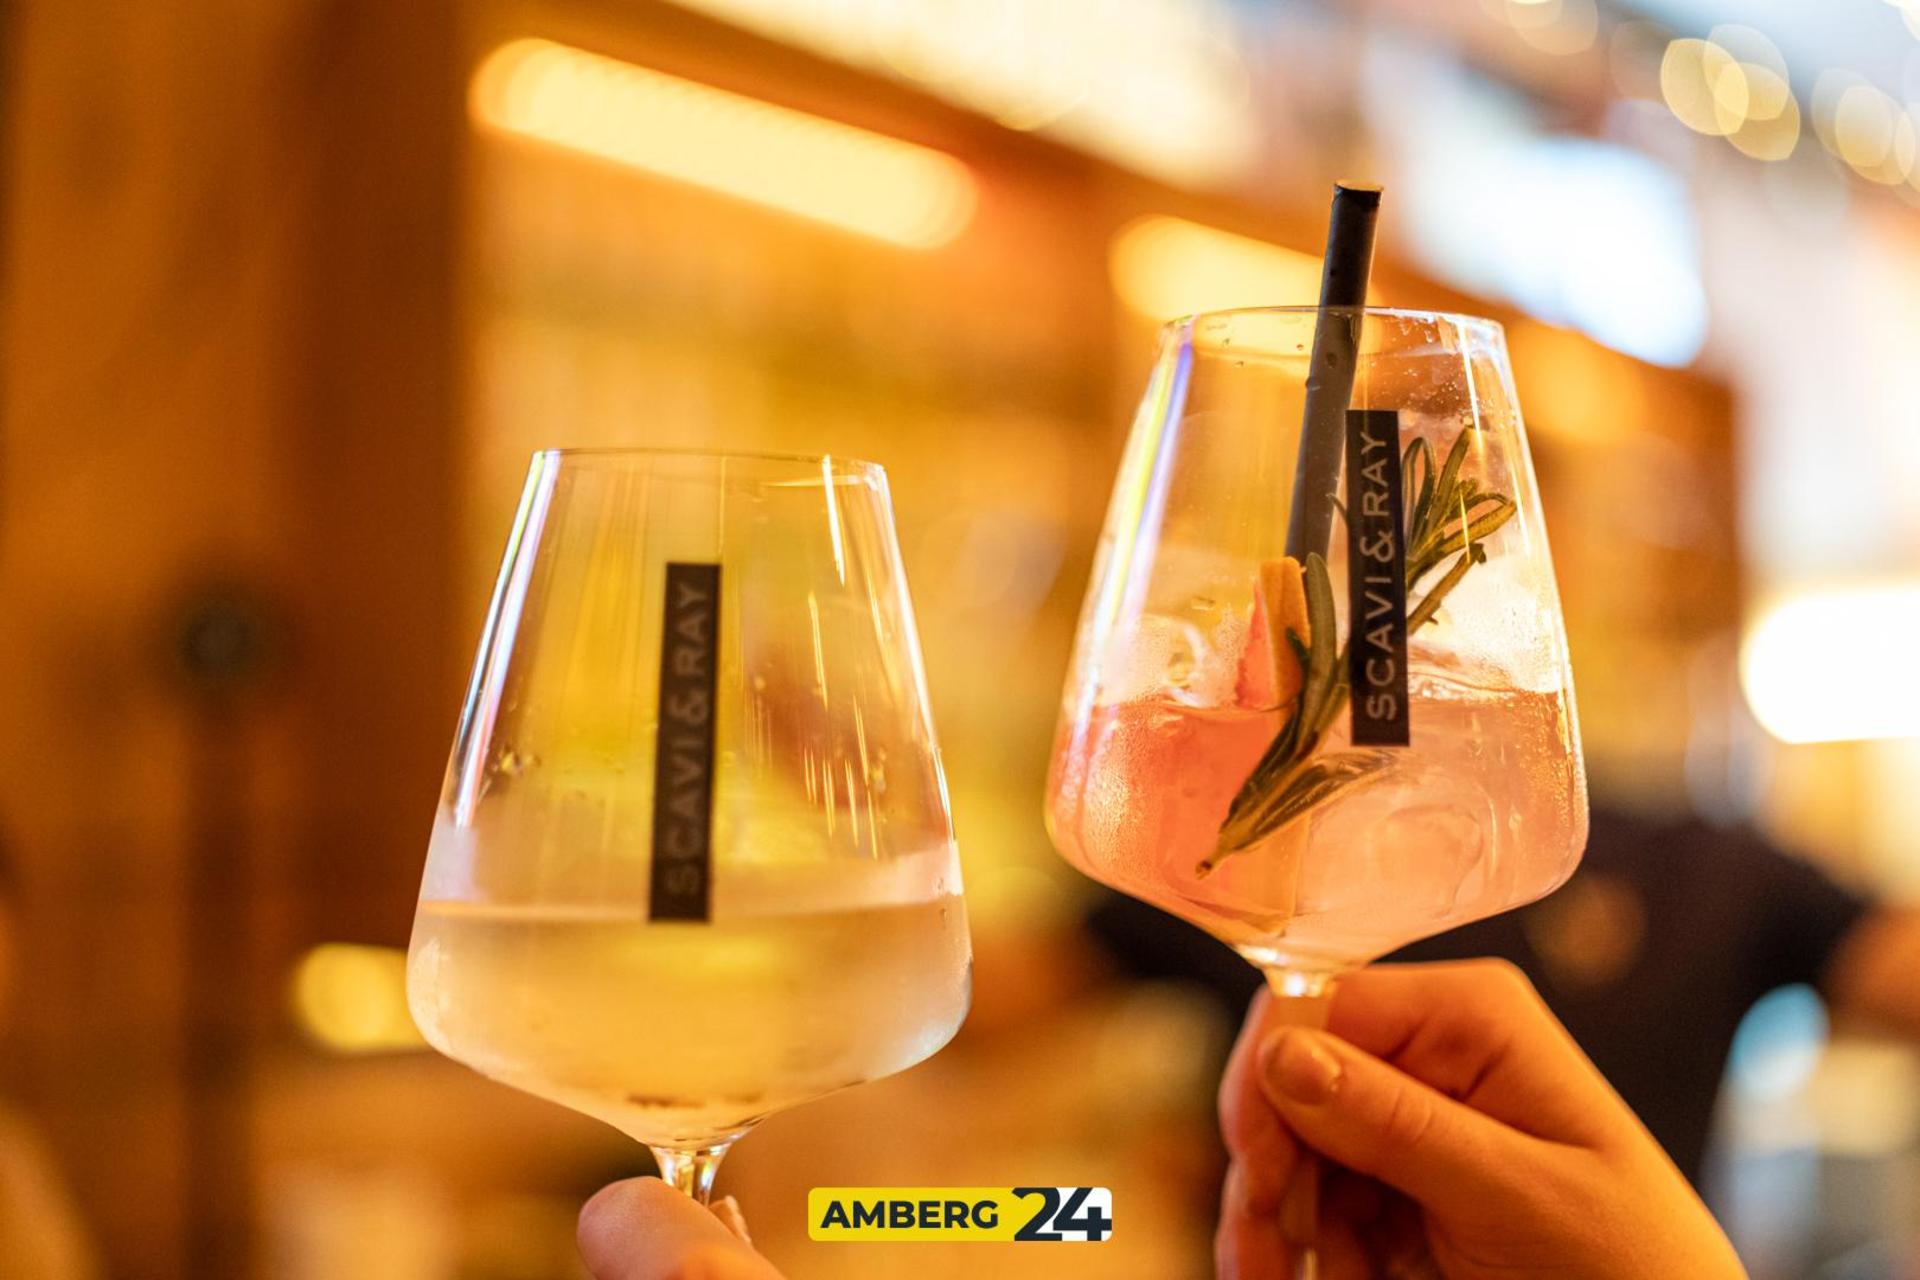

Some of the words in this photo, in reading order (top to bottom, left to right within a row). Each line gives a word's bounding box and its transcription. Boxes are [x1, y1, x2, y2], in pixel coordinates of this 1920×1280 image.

[1360, 431, 1390, 517] RAY
[1359, 530, 1396, 564] &
[673, 581, 708, 678] RAY
[1364, 576, 1397, 721] SCAVI
[667, 690, 710, 724] &
[664, 736, 705, 895] SCAVI
